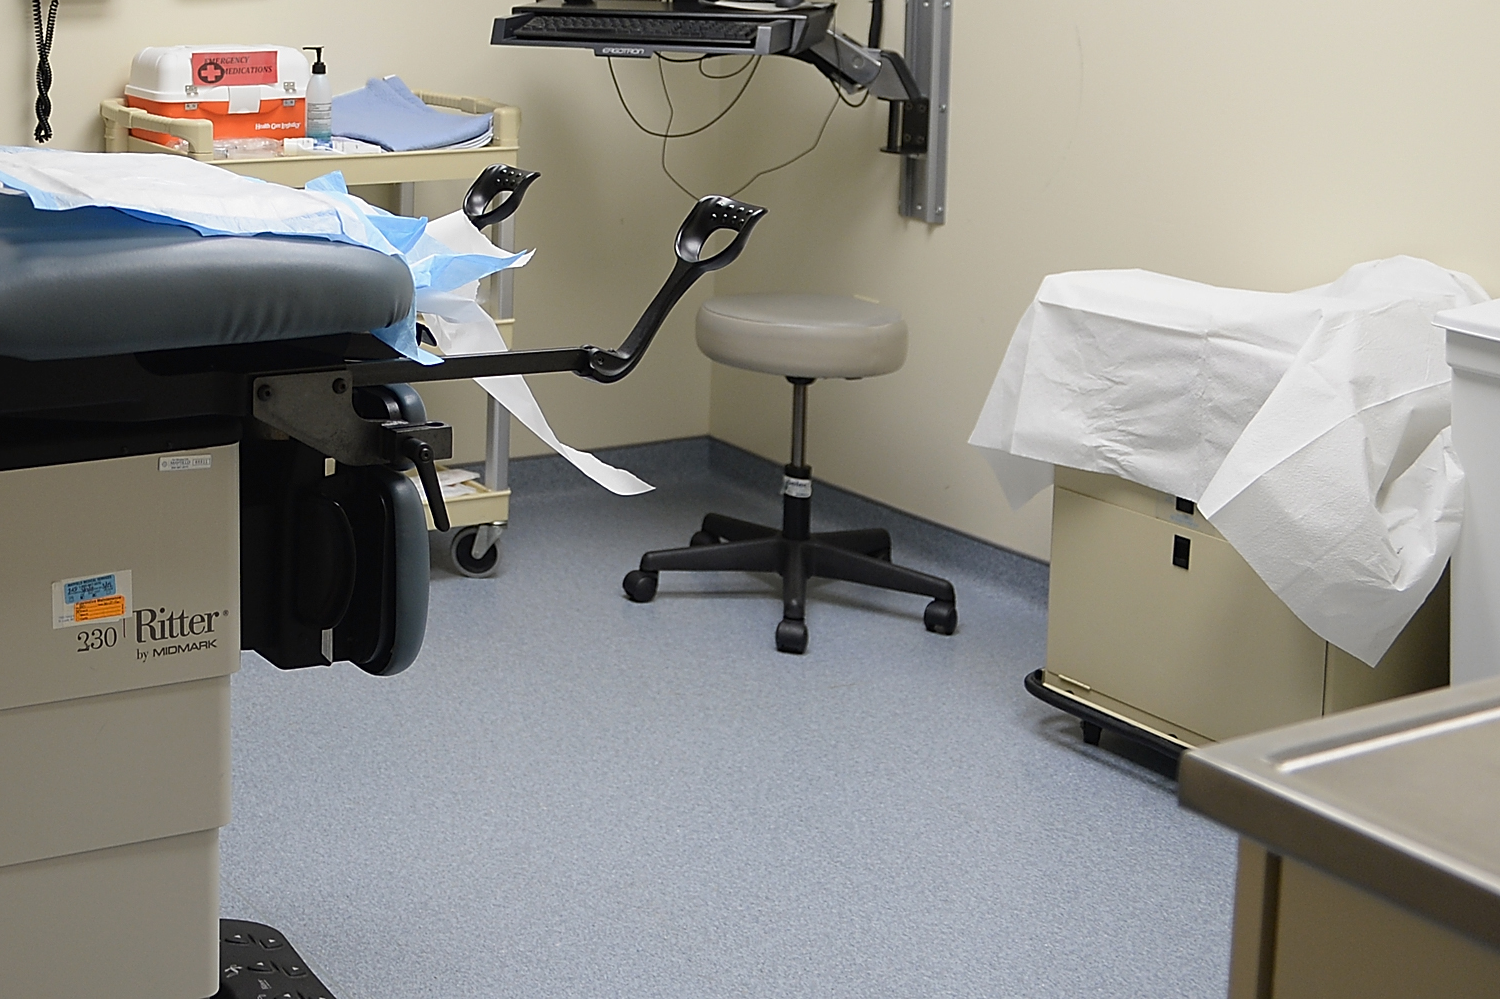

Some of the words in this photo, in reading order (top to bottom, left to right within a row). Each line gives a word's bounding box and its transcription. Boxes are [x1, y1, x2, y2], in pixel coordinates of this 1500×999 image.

[204, 56, 251, 65] EMERGENCY
[76, 626, 118, 653] 230
[136, 648, 150, 663] by
[152, 638, 218, 658] MIDMARK
